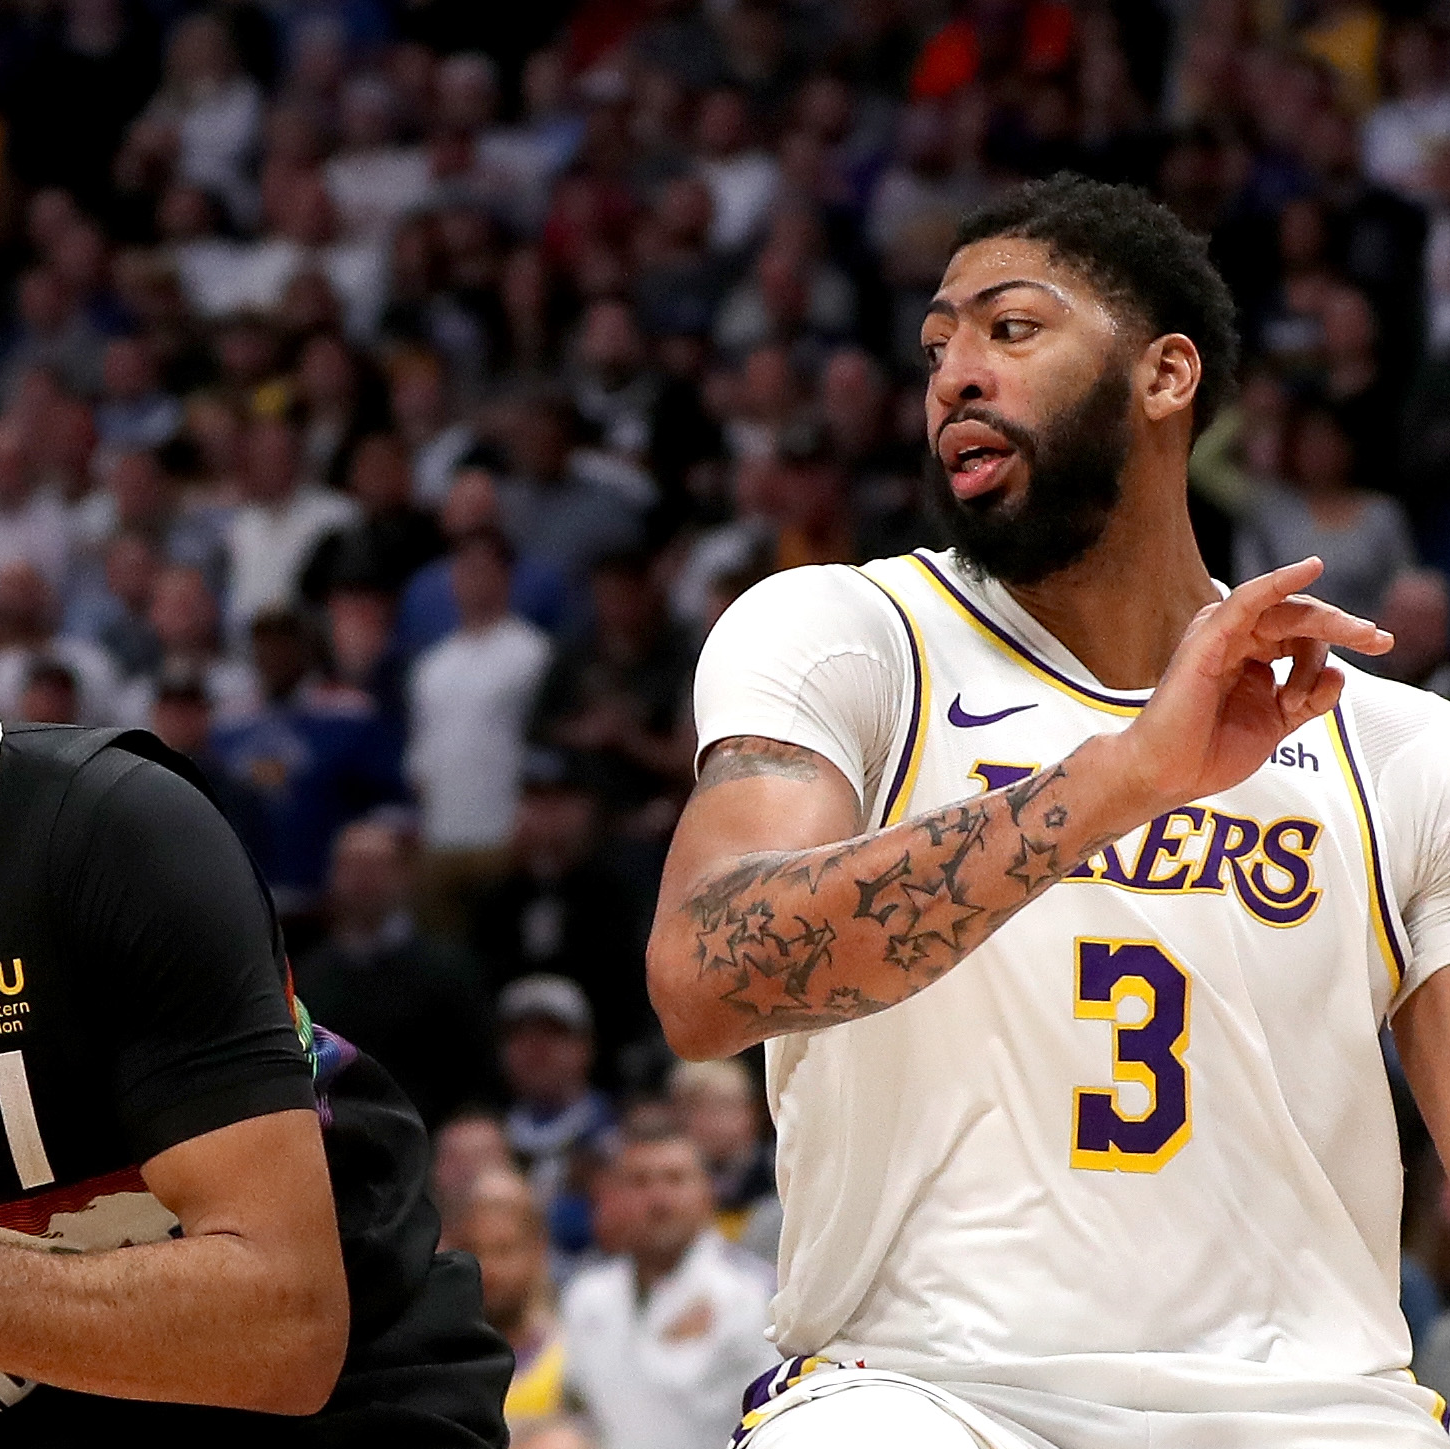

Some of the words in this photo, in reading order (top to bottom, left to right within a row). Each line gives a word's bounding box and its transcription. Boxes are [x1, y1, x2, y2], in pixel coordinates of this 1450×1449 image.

[1270, 741, 1319, 773] ish
[967, 758, 1324, 929] ERS
[1070, 936, 1192, 1173] 3
